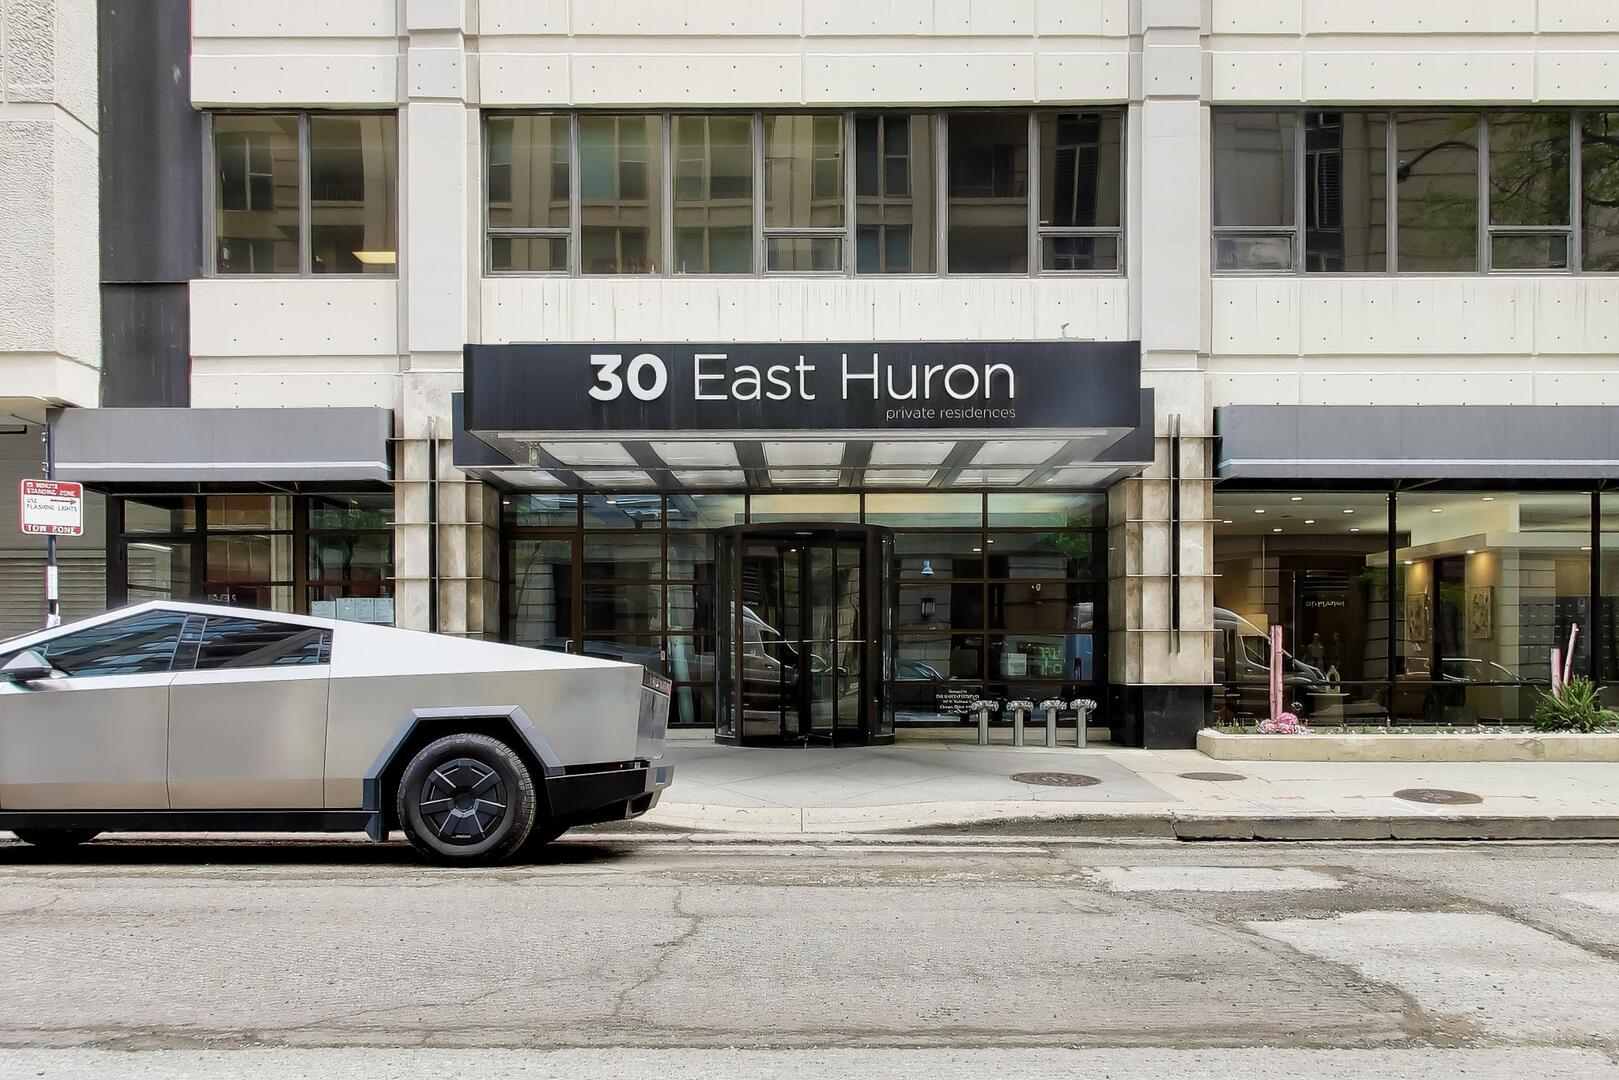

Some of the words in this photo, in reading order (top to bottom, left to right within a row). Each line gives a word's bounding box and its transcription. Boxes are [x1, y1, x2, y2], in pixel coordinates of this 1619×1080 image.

[588, 354, 668, 401] 30
[694, 354, 816, 401] East
[842, 353, 1015, 400] Huron
[886, 407, 936, 421] private
[940, 407, 1016, 419] residences
[52, 526, 78, 534] ZONE
